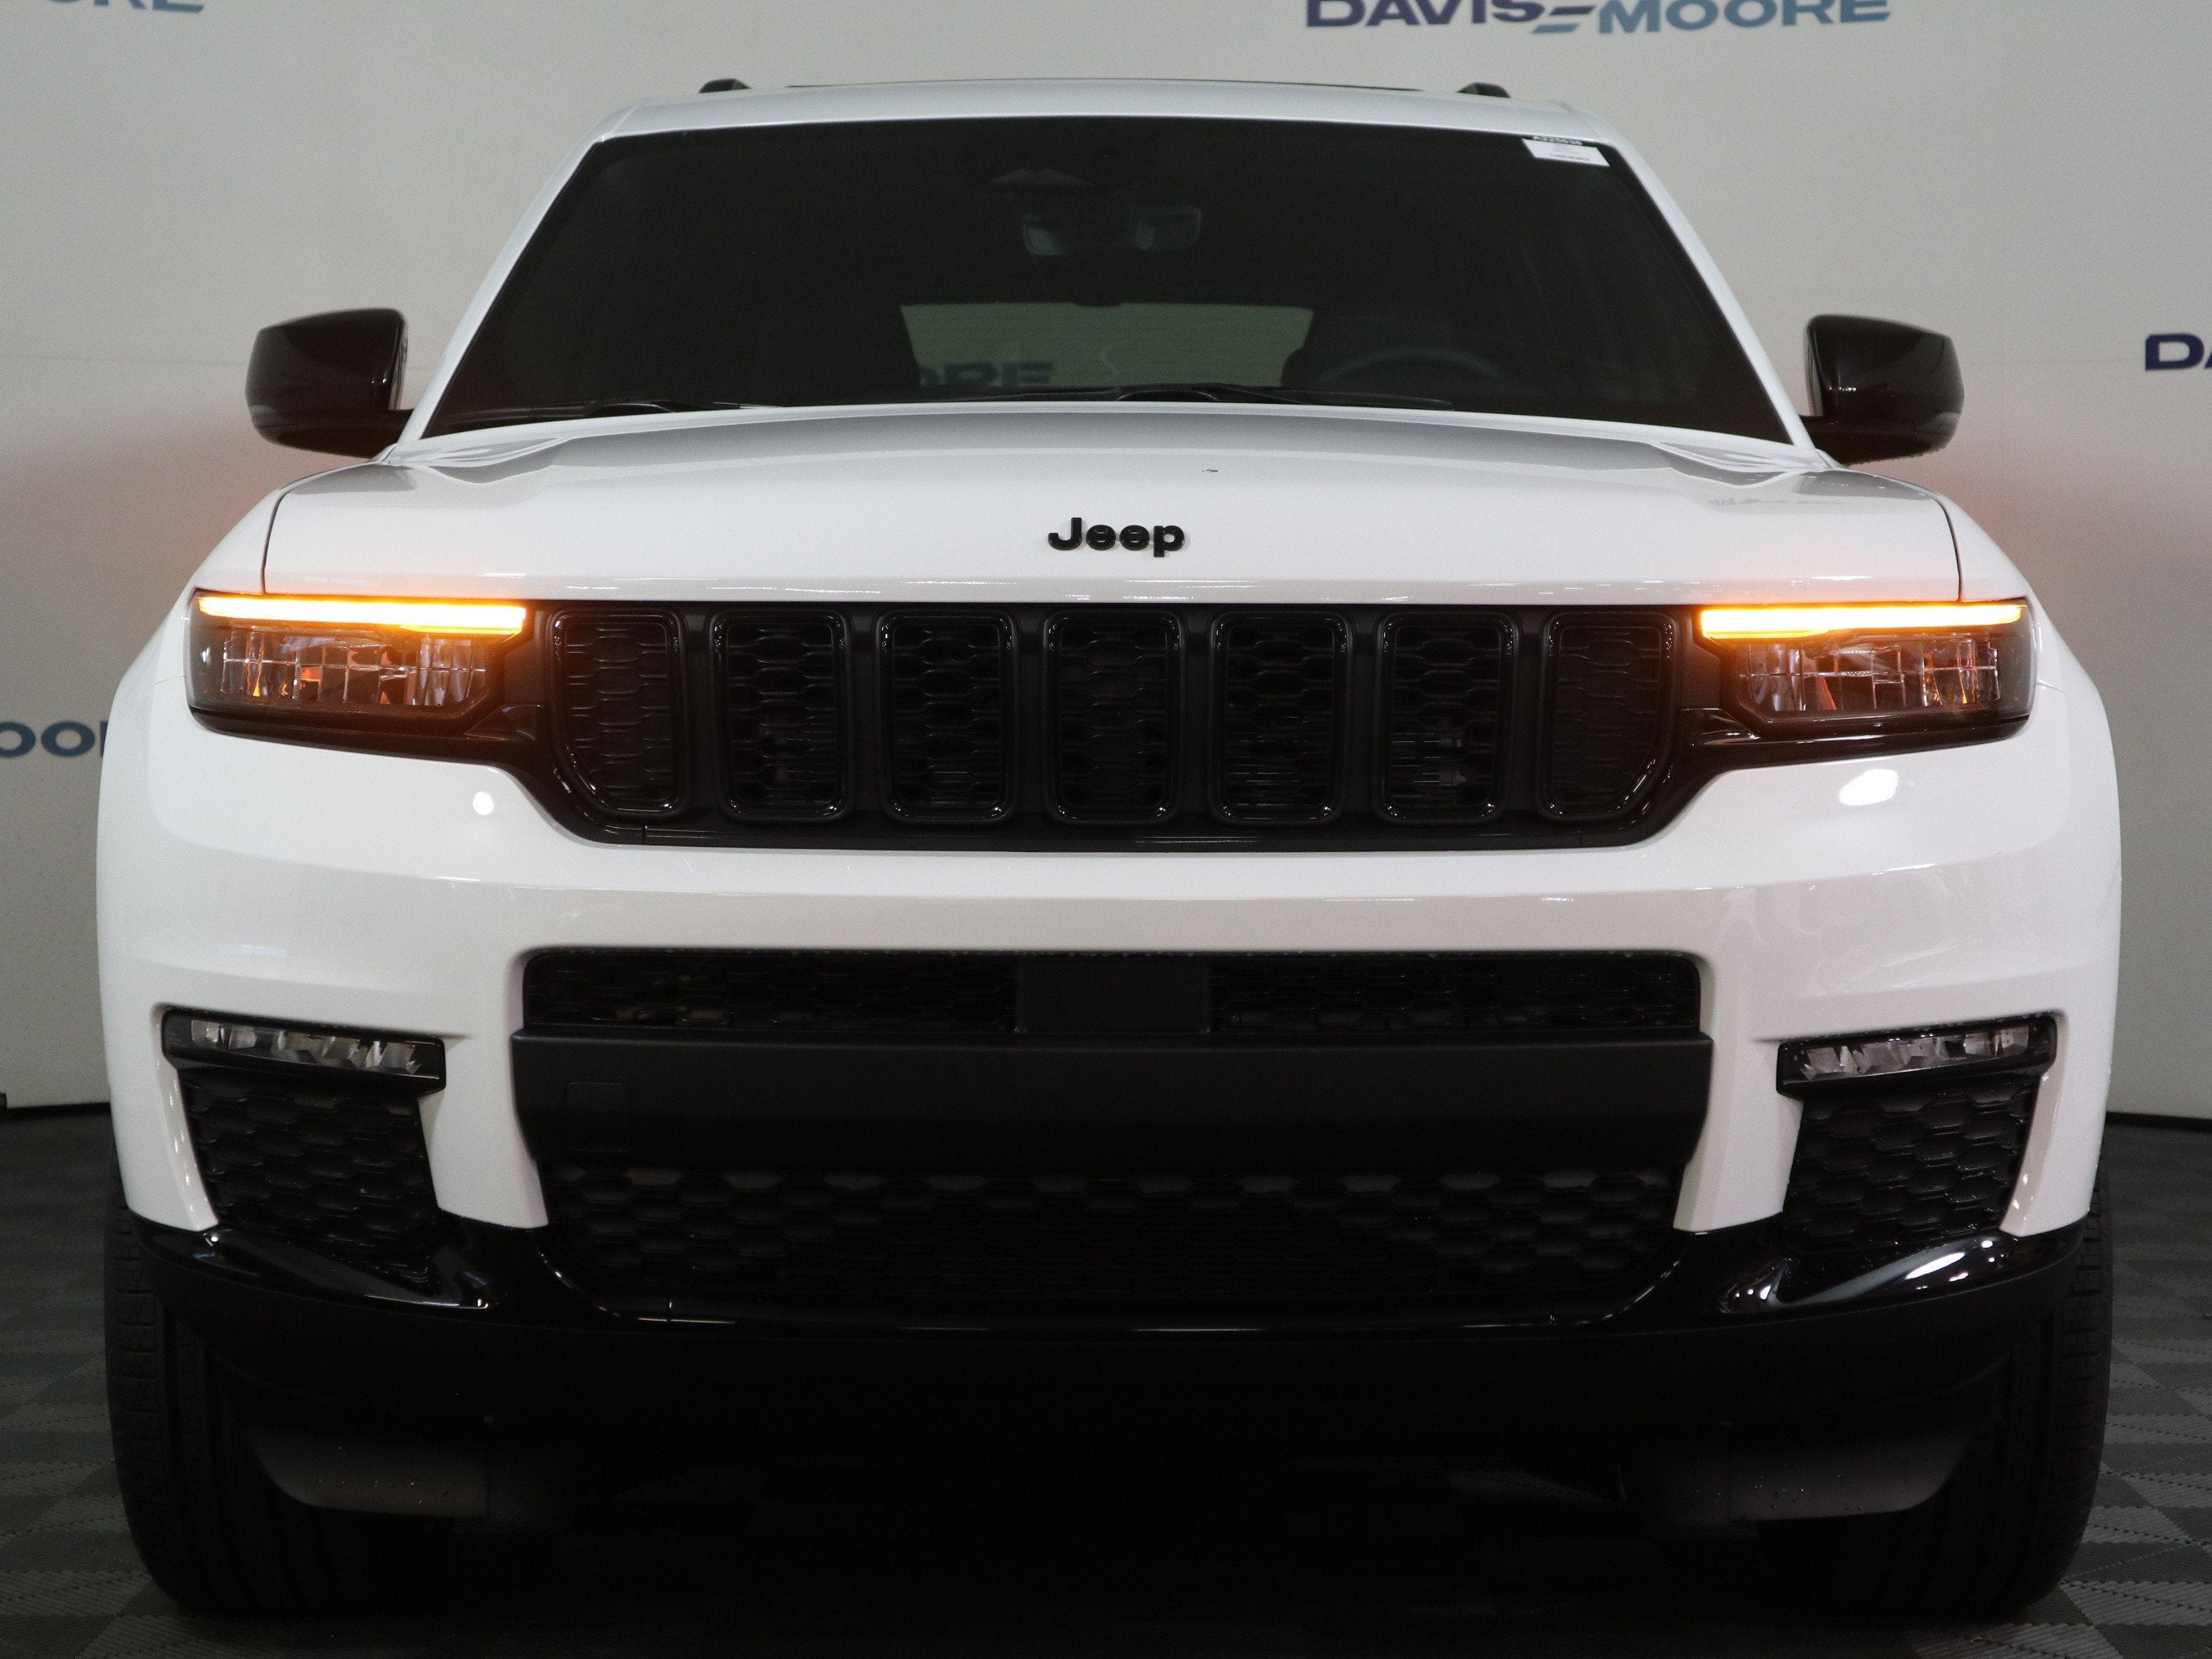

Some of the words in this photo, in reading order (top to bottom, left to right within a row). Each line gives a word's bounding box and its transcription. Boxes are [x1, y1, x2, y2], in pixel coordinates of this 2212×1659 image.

[2145, 333, 2212, 371] D
[1048, 517, 1185, 557] Jeep
[0, 720, 108, 758] OO
